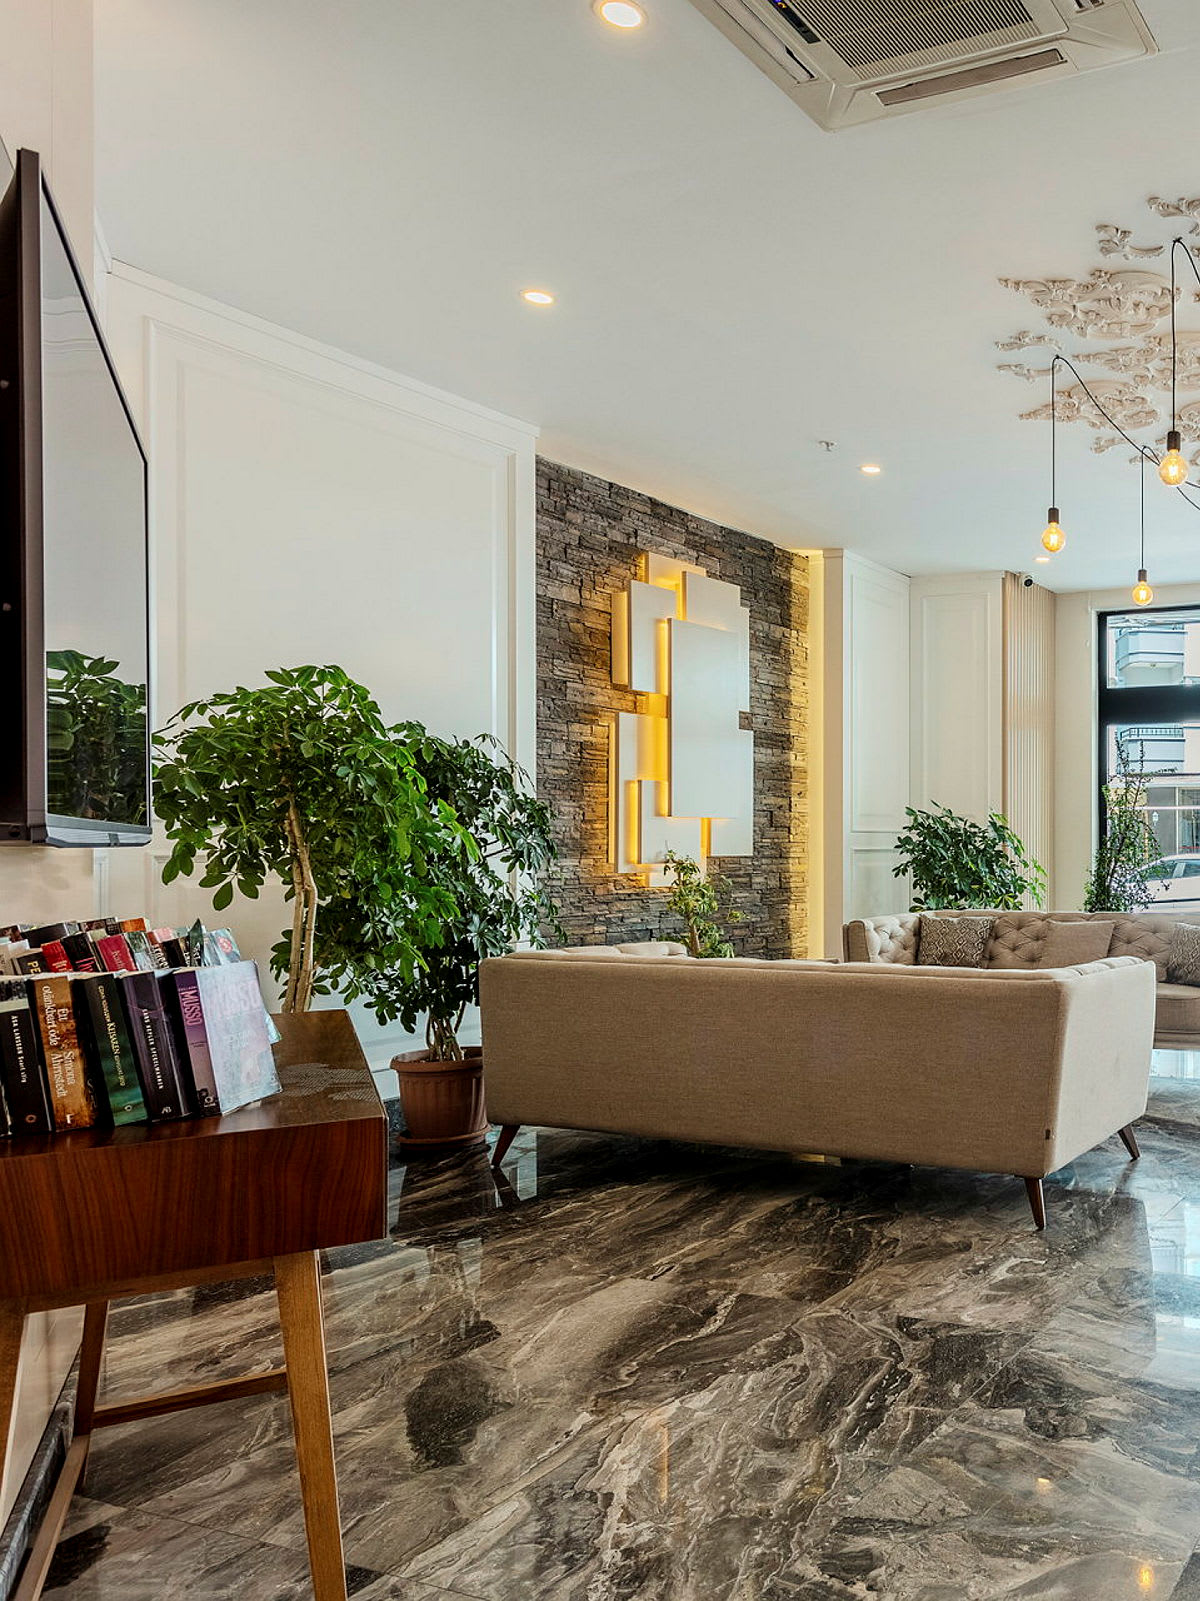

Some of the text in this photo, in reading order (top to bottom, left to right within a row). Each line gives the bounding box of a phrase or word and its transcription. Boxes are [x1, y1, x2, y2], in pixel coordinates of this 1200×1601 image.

[183, 986, 203, 1026] MUSSO
[14, 1026, 24, 1053] LARSSON
[51, 1052, 68, 1098] Ahrnstedt
[62, 1050, 76, 1085] Simona
